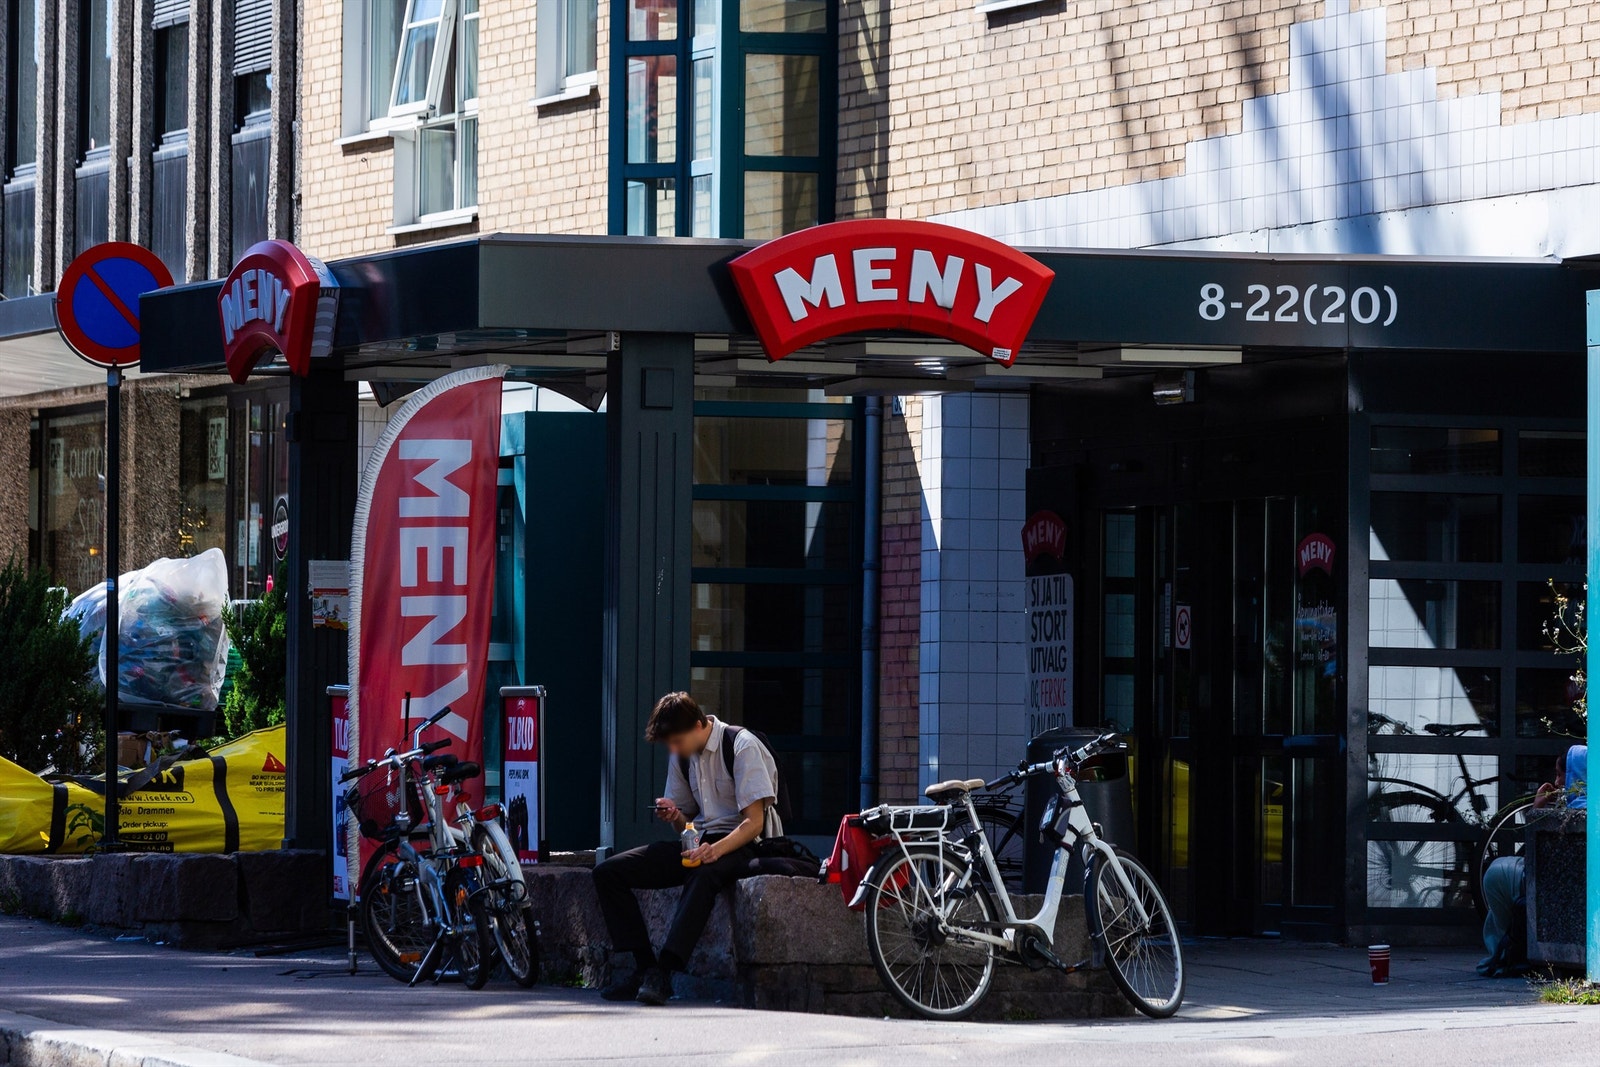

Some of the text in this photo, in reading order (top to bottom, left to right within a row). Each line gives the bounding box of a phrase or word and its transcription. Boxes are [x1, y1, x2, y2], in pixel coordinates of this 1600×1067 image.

[773, 247, 1024, 323] MENY
[221, 268, 292, 345] MENY
[1198, 283, 1398, 327] 8-22(20)
[1028, 522, 1063, 551] MENY
[1301, 541, 1332, 566] MENY
[398, 439, 473, 743] MENY
[1031, 576, 1067, 607] SI JA TIL
[1031, 610, 1067, 643] STORT
[1031, 645, 1067, 674] UTVALG
[1040, 677, 1067, 707] FERSKE
[334, 717, 348, 751] TILB
[508, 716, 534, 751] TILBUD
[122, 820, 168, 829] Order pickup:
[137, 806, 175, 815] Drammen
